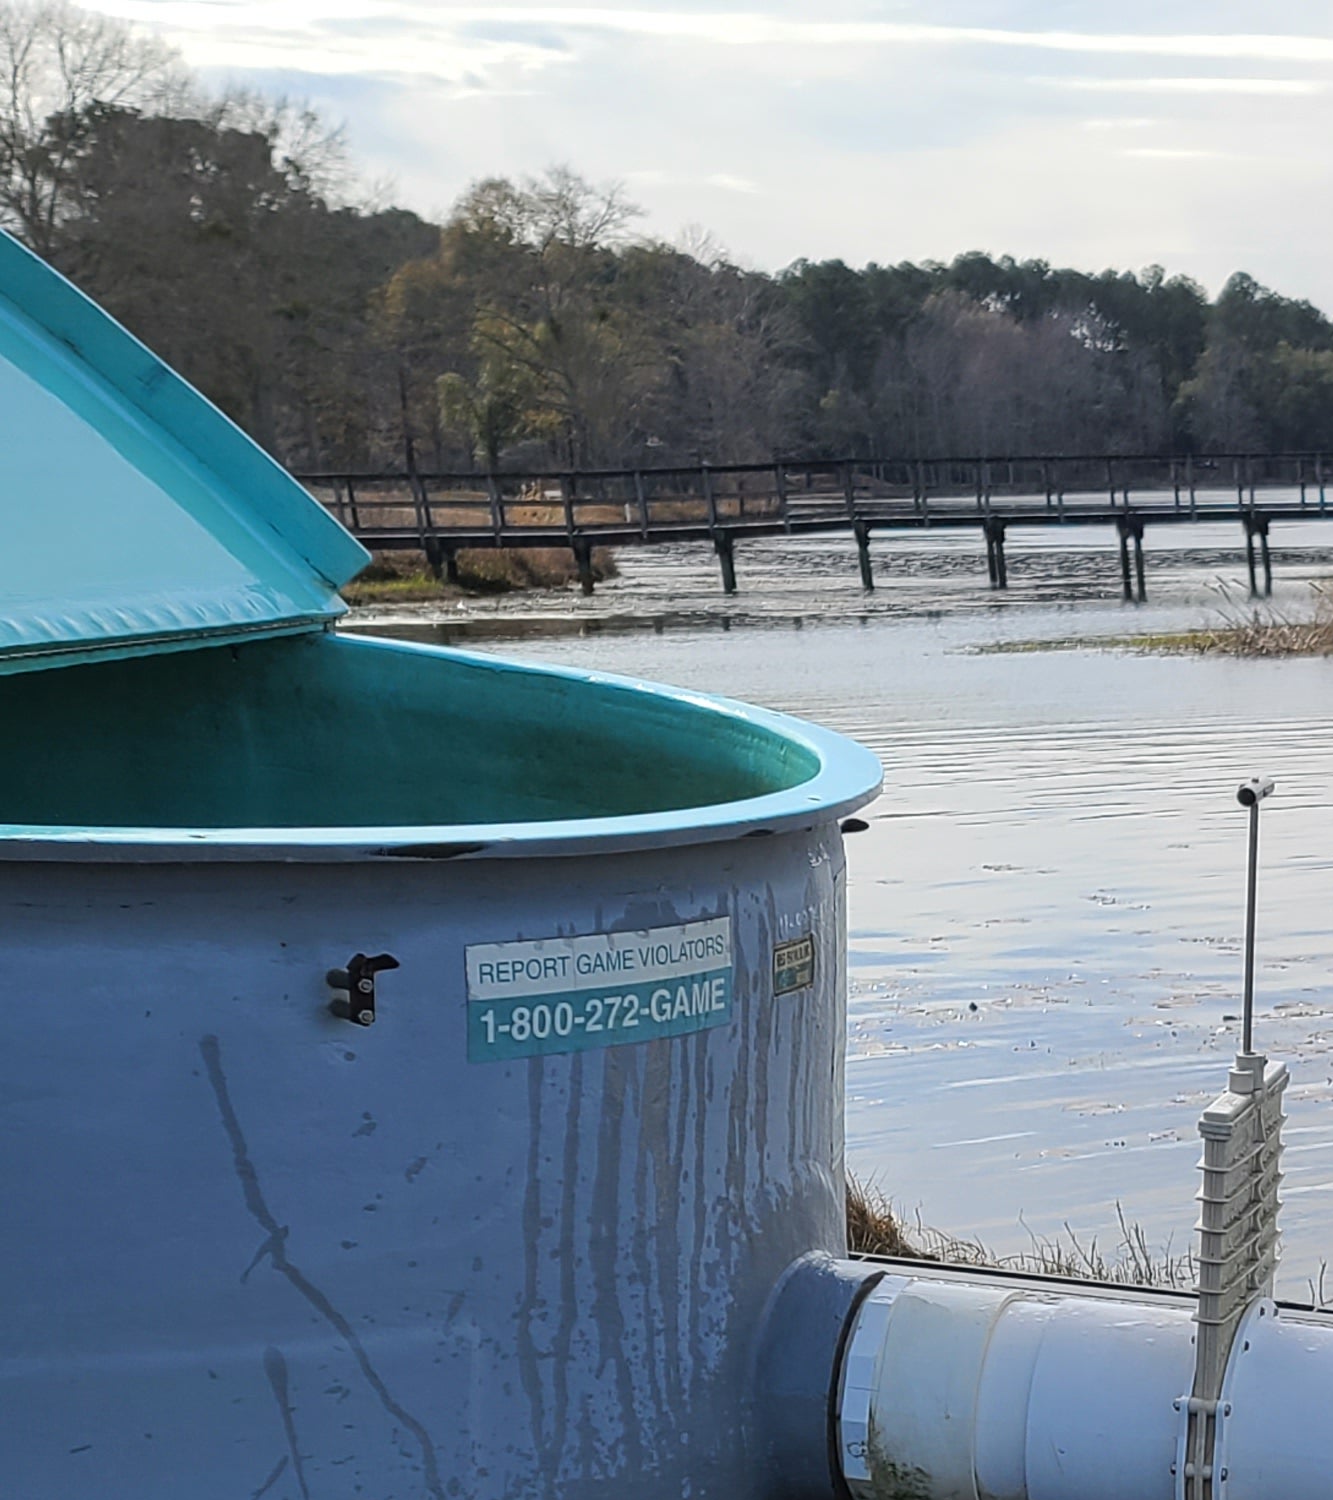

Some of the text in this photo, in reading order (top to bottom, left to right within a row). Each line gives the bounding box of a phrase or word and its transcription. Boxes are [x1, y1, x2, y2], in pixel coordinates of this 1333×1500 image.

[479, 934, 724, 984] REPORT GAME VIOLATORS
[480, 977, 726, 1044] 1-800-272-GAME
